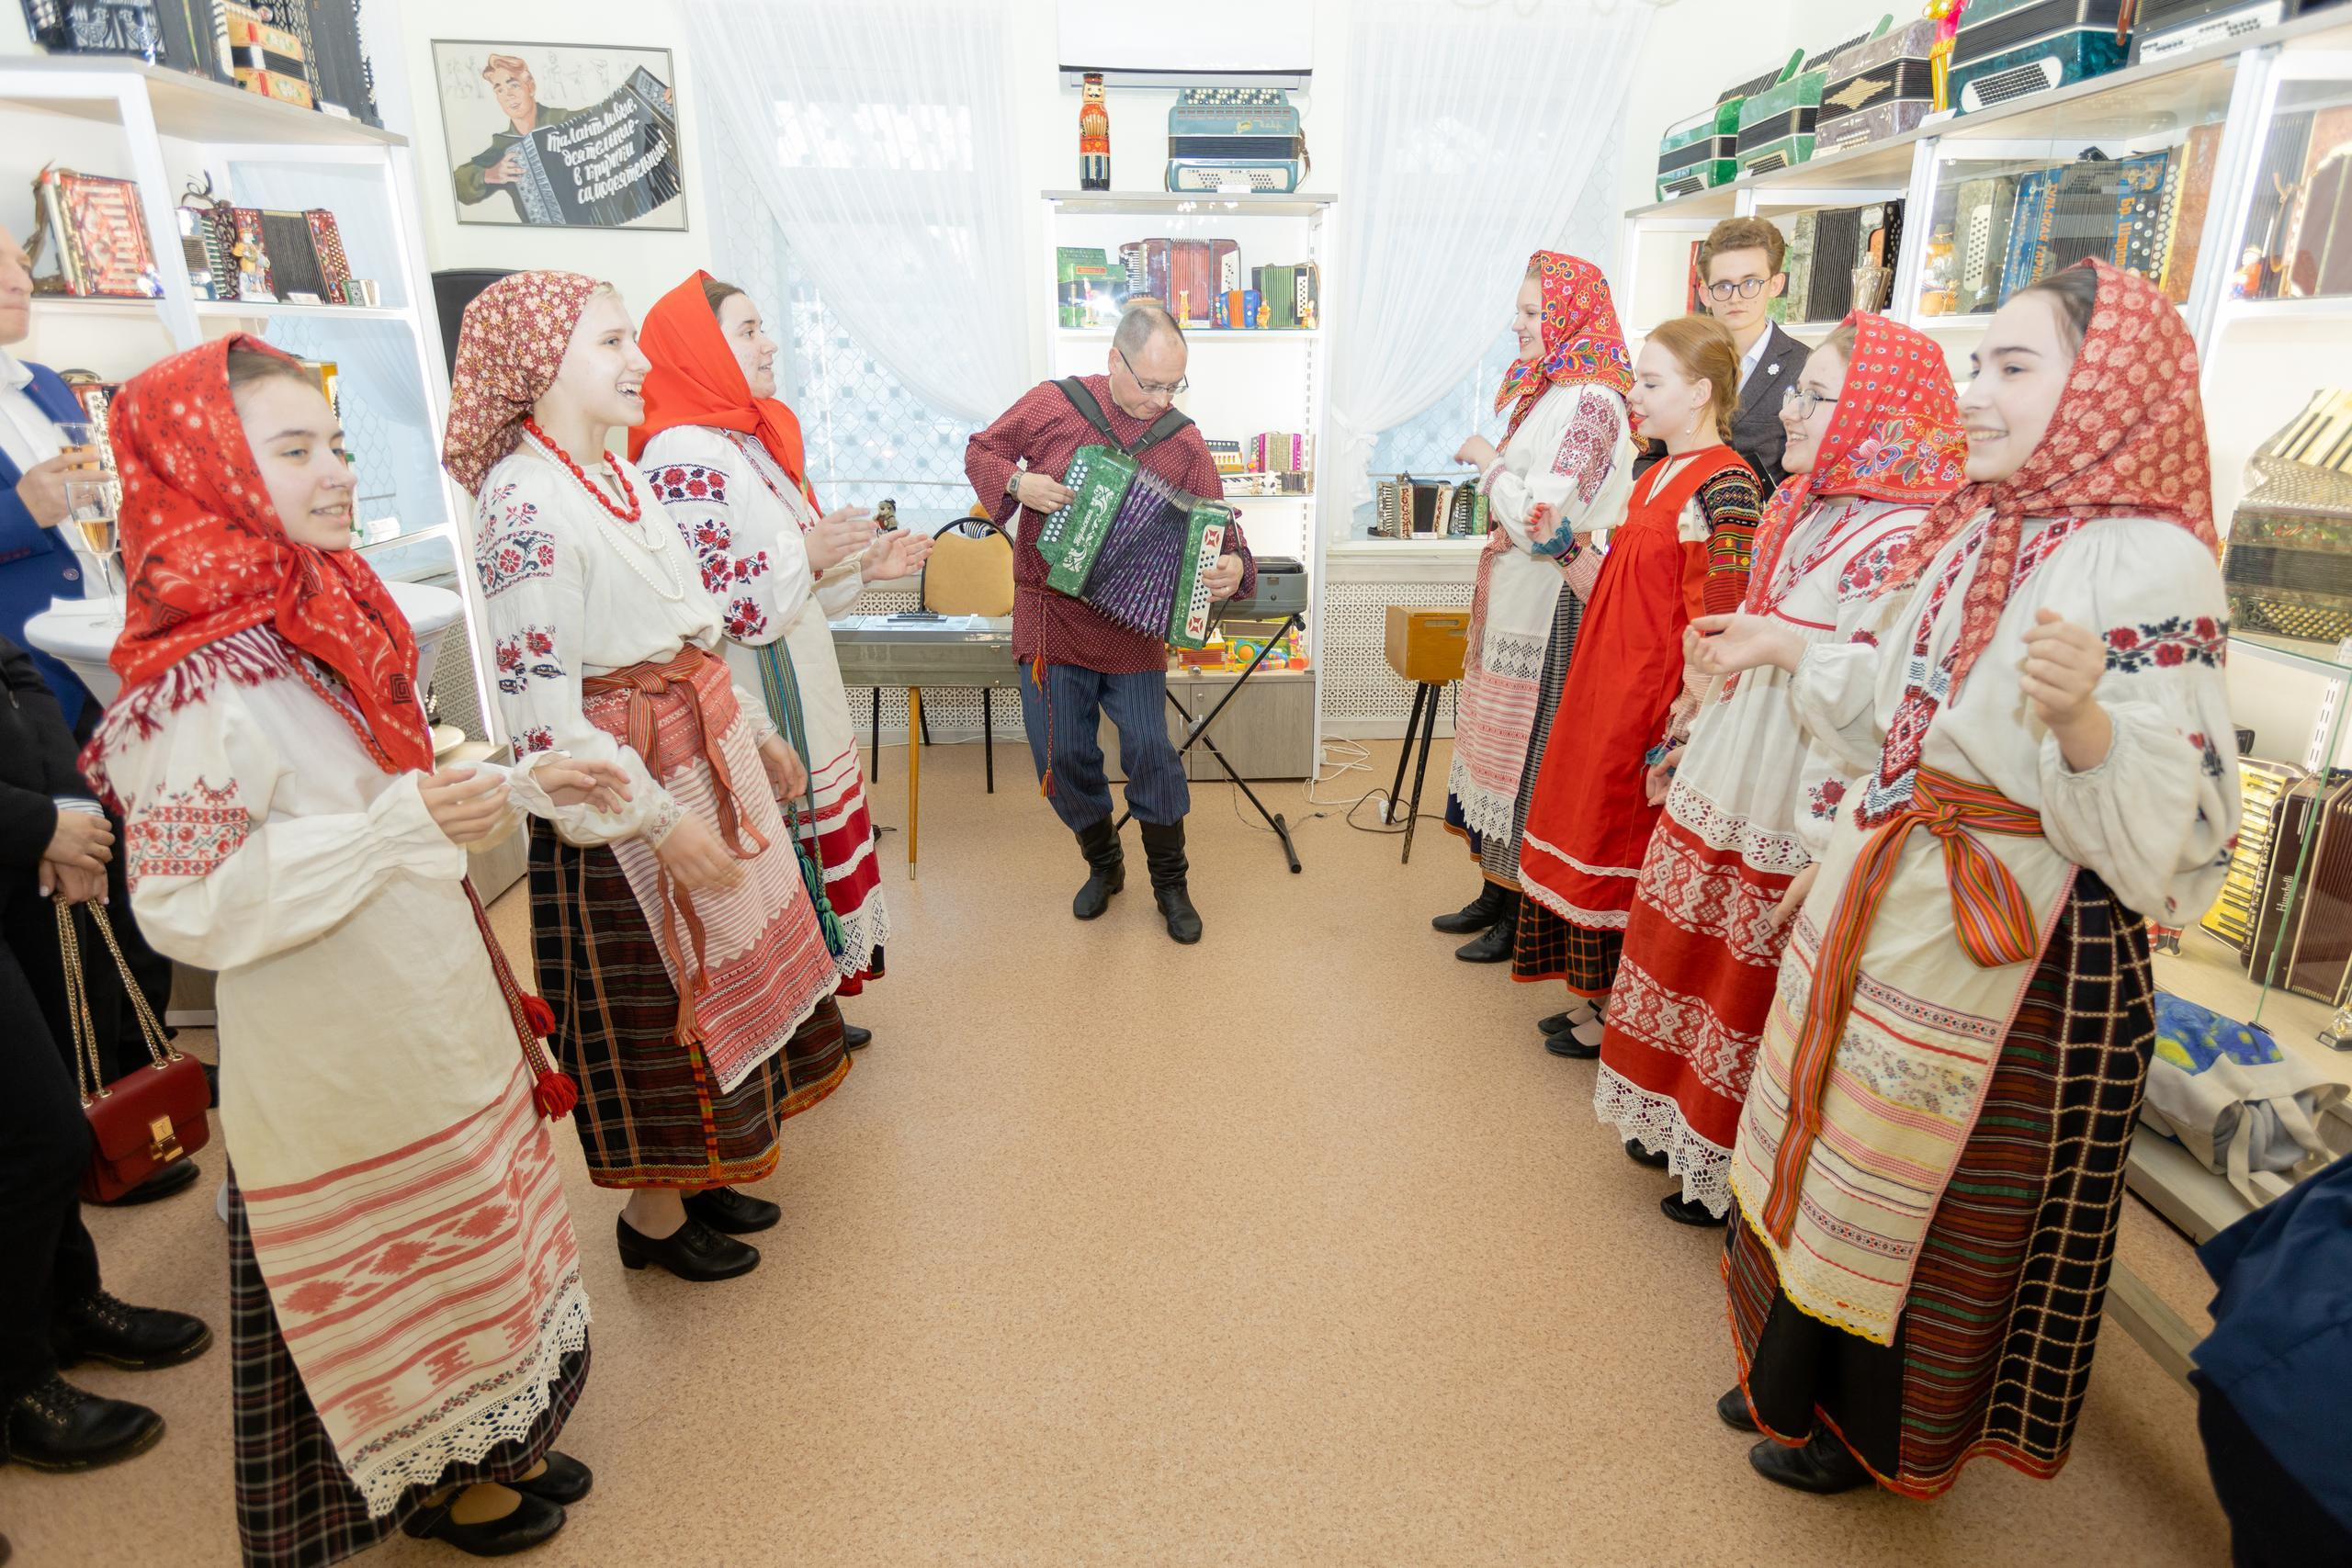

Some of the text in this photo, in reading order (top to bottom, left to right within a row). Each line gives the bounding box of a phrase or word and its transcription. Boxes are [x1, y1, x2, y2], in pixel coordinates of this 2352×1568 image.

[573, 141, 635, 186] в кружки
[577, 129, 673, 204] самодеятельные!
